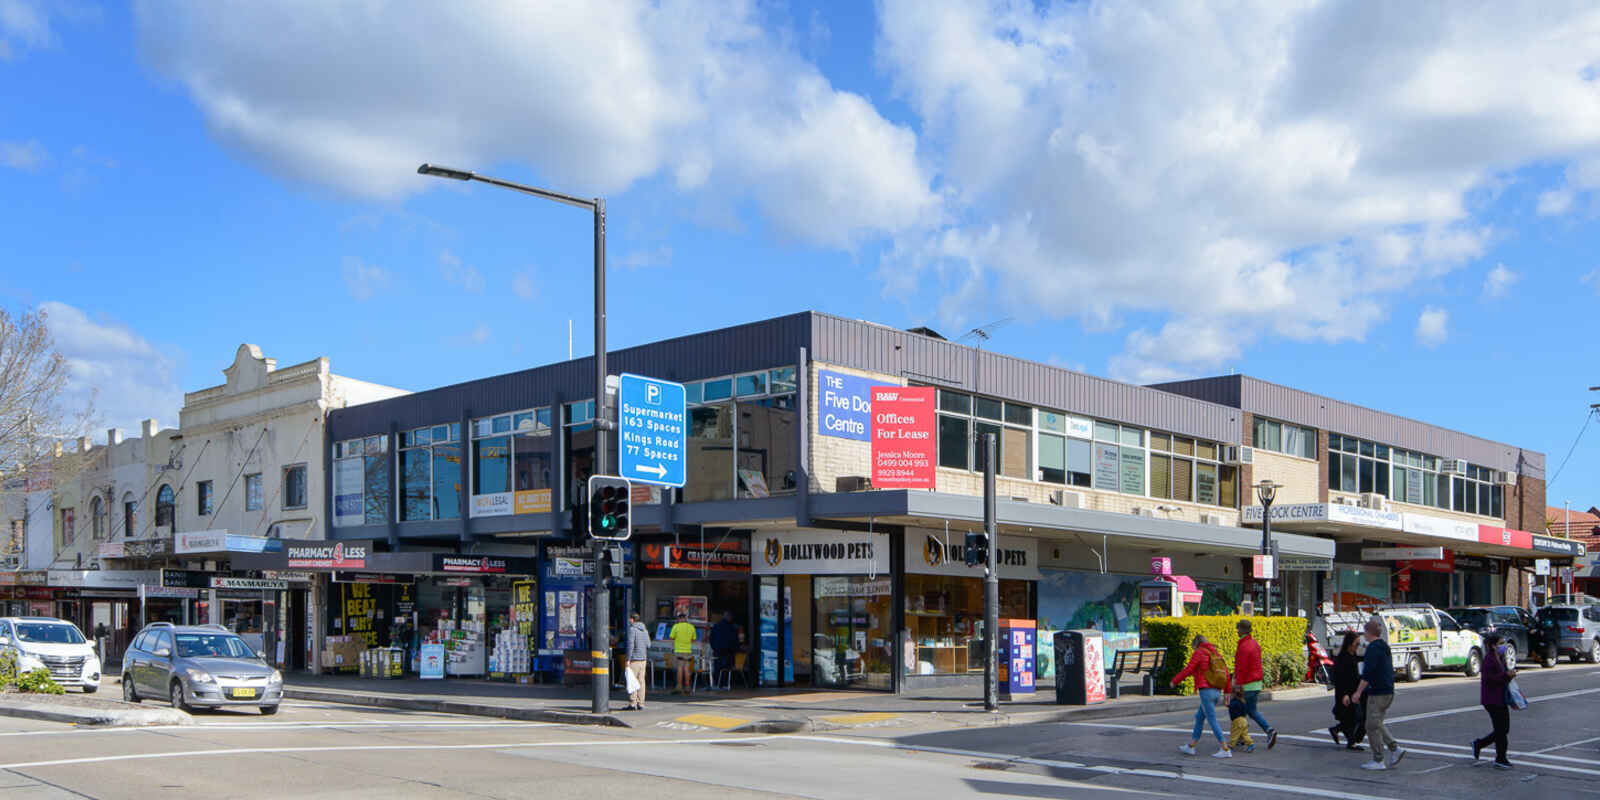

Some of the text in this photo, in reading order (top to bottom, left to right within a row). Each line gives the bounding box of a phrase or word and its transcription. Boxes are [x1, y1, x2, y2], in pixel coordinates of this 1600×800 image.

[825, 376, 844, 389] THE
[825, 391, 849, 410] Five
[623, 403, 682, 422] Supermarket
[876, 413, 915, 425] Offices
[624, 416, 681, 434] 163 Spaces
[825, 414, 865, 434] Centre
[624, 431, 679, 449] Kings Road
[877, 428, 929, 439] For Lease
[626, 445, 678, 462] 77 Spaces
[1245, 505, 1324, 519] FIVE OCK CENTRE
[288, 547, 333, 559] PHARMACY
[344, 547, 365, 558] LESS
[784, 542, 873, 560] HOLLYWOOD PETS
[1005, 549, 1026, 566] PETS
[443, 558, 481, 567] PHARMACY
[351, 583, 371, 599] WE
[347, 599, 376, 616] BEAT
